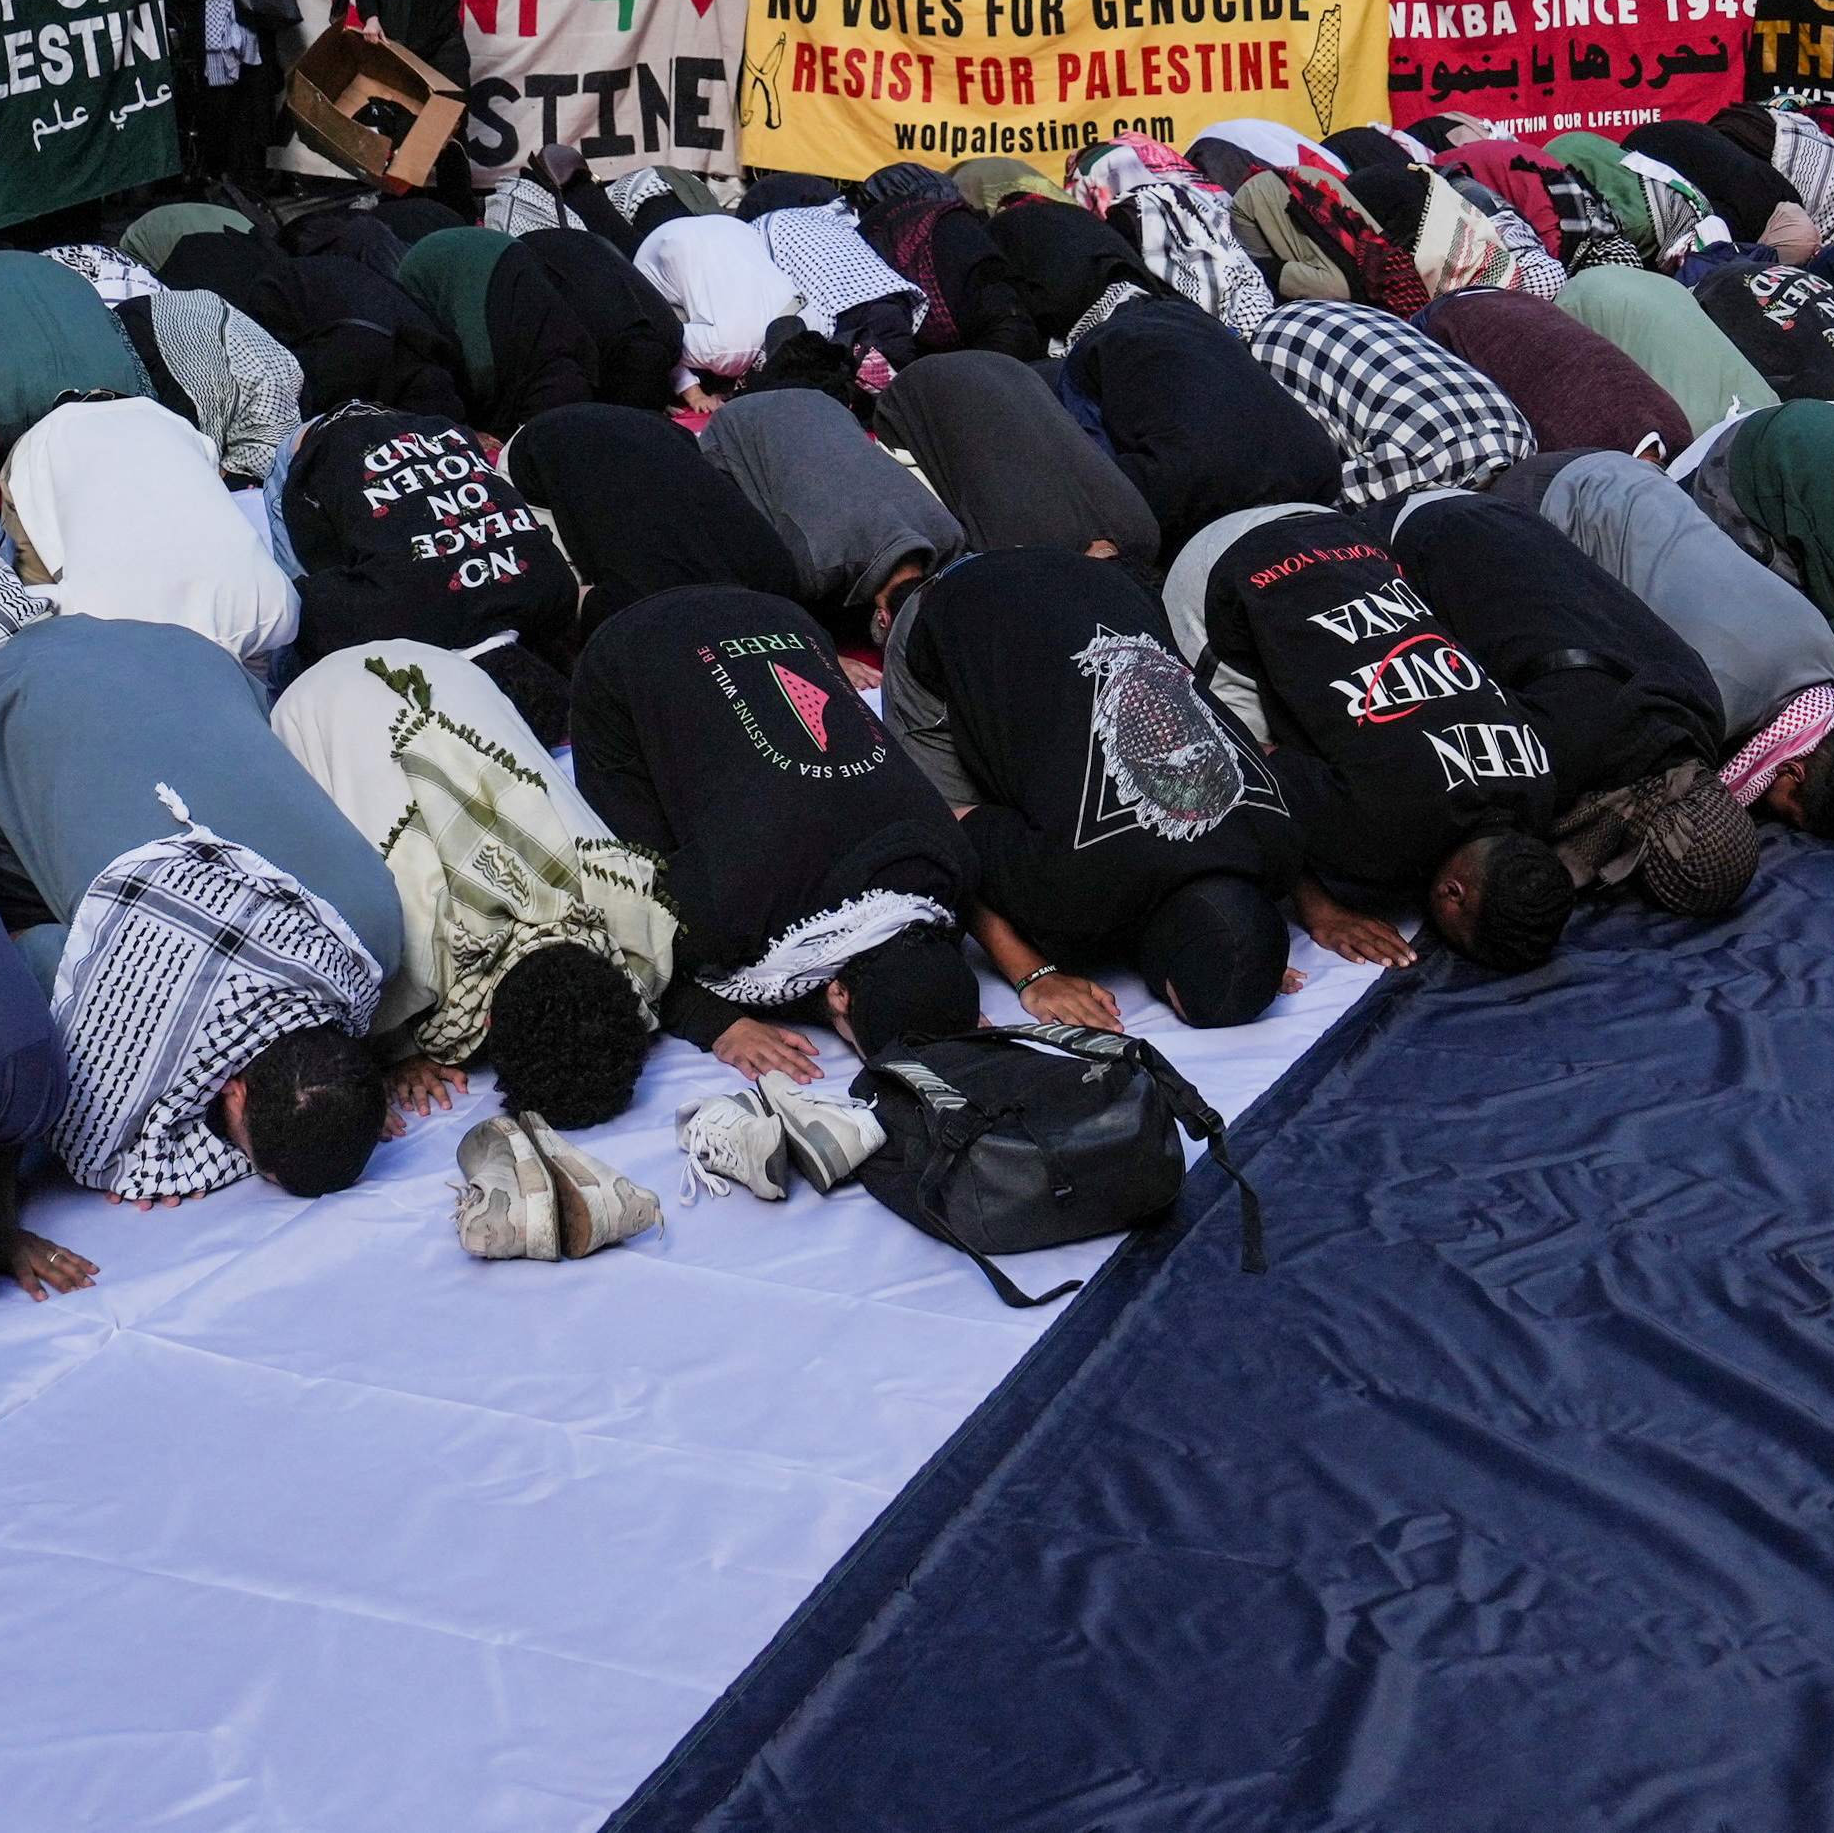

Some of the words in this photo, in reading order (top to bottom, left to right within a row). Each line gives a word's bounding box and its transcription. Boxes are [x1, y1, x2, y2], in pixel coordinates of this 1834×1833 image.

[1389, 0, 1517, 39] NAKBA
[792, 40, 935, 104] RESIST
[957, 53, 1052, 107] FOR
[1065, 40, 1291, 103] PALESTINE
[1495, 116, 1547, 134] WITHIN
[1553, 112, 1583, 130] OUR
[1588, 108, 1662, 128] LIFETIME
[427, 482, 489, 521] ON
[411, 509, 537, 559] PEACE
[459, 547, 521, 588] NO
[1250, 553, 1315, 589] YOURS
[697, 645, 715, 663] BE
[719, 633, 805, 659] FREE
[711, 663, 739, 699] WILL
[1329, 647, 1482, 717] OVER
[733, 699, 792, 770] PALESTINE
[799, 763, 833, 778] SEA
[839, 759, 875, 778] THE
[872, 745, 886, 763] TO
[1422, 723, 1550, 792] DEEN
